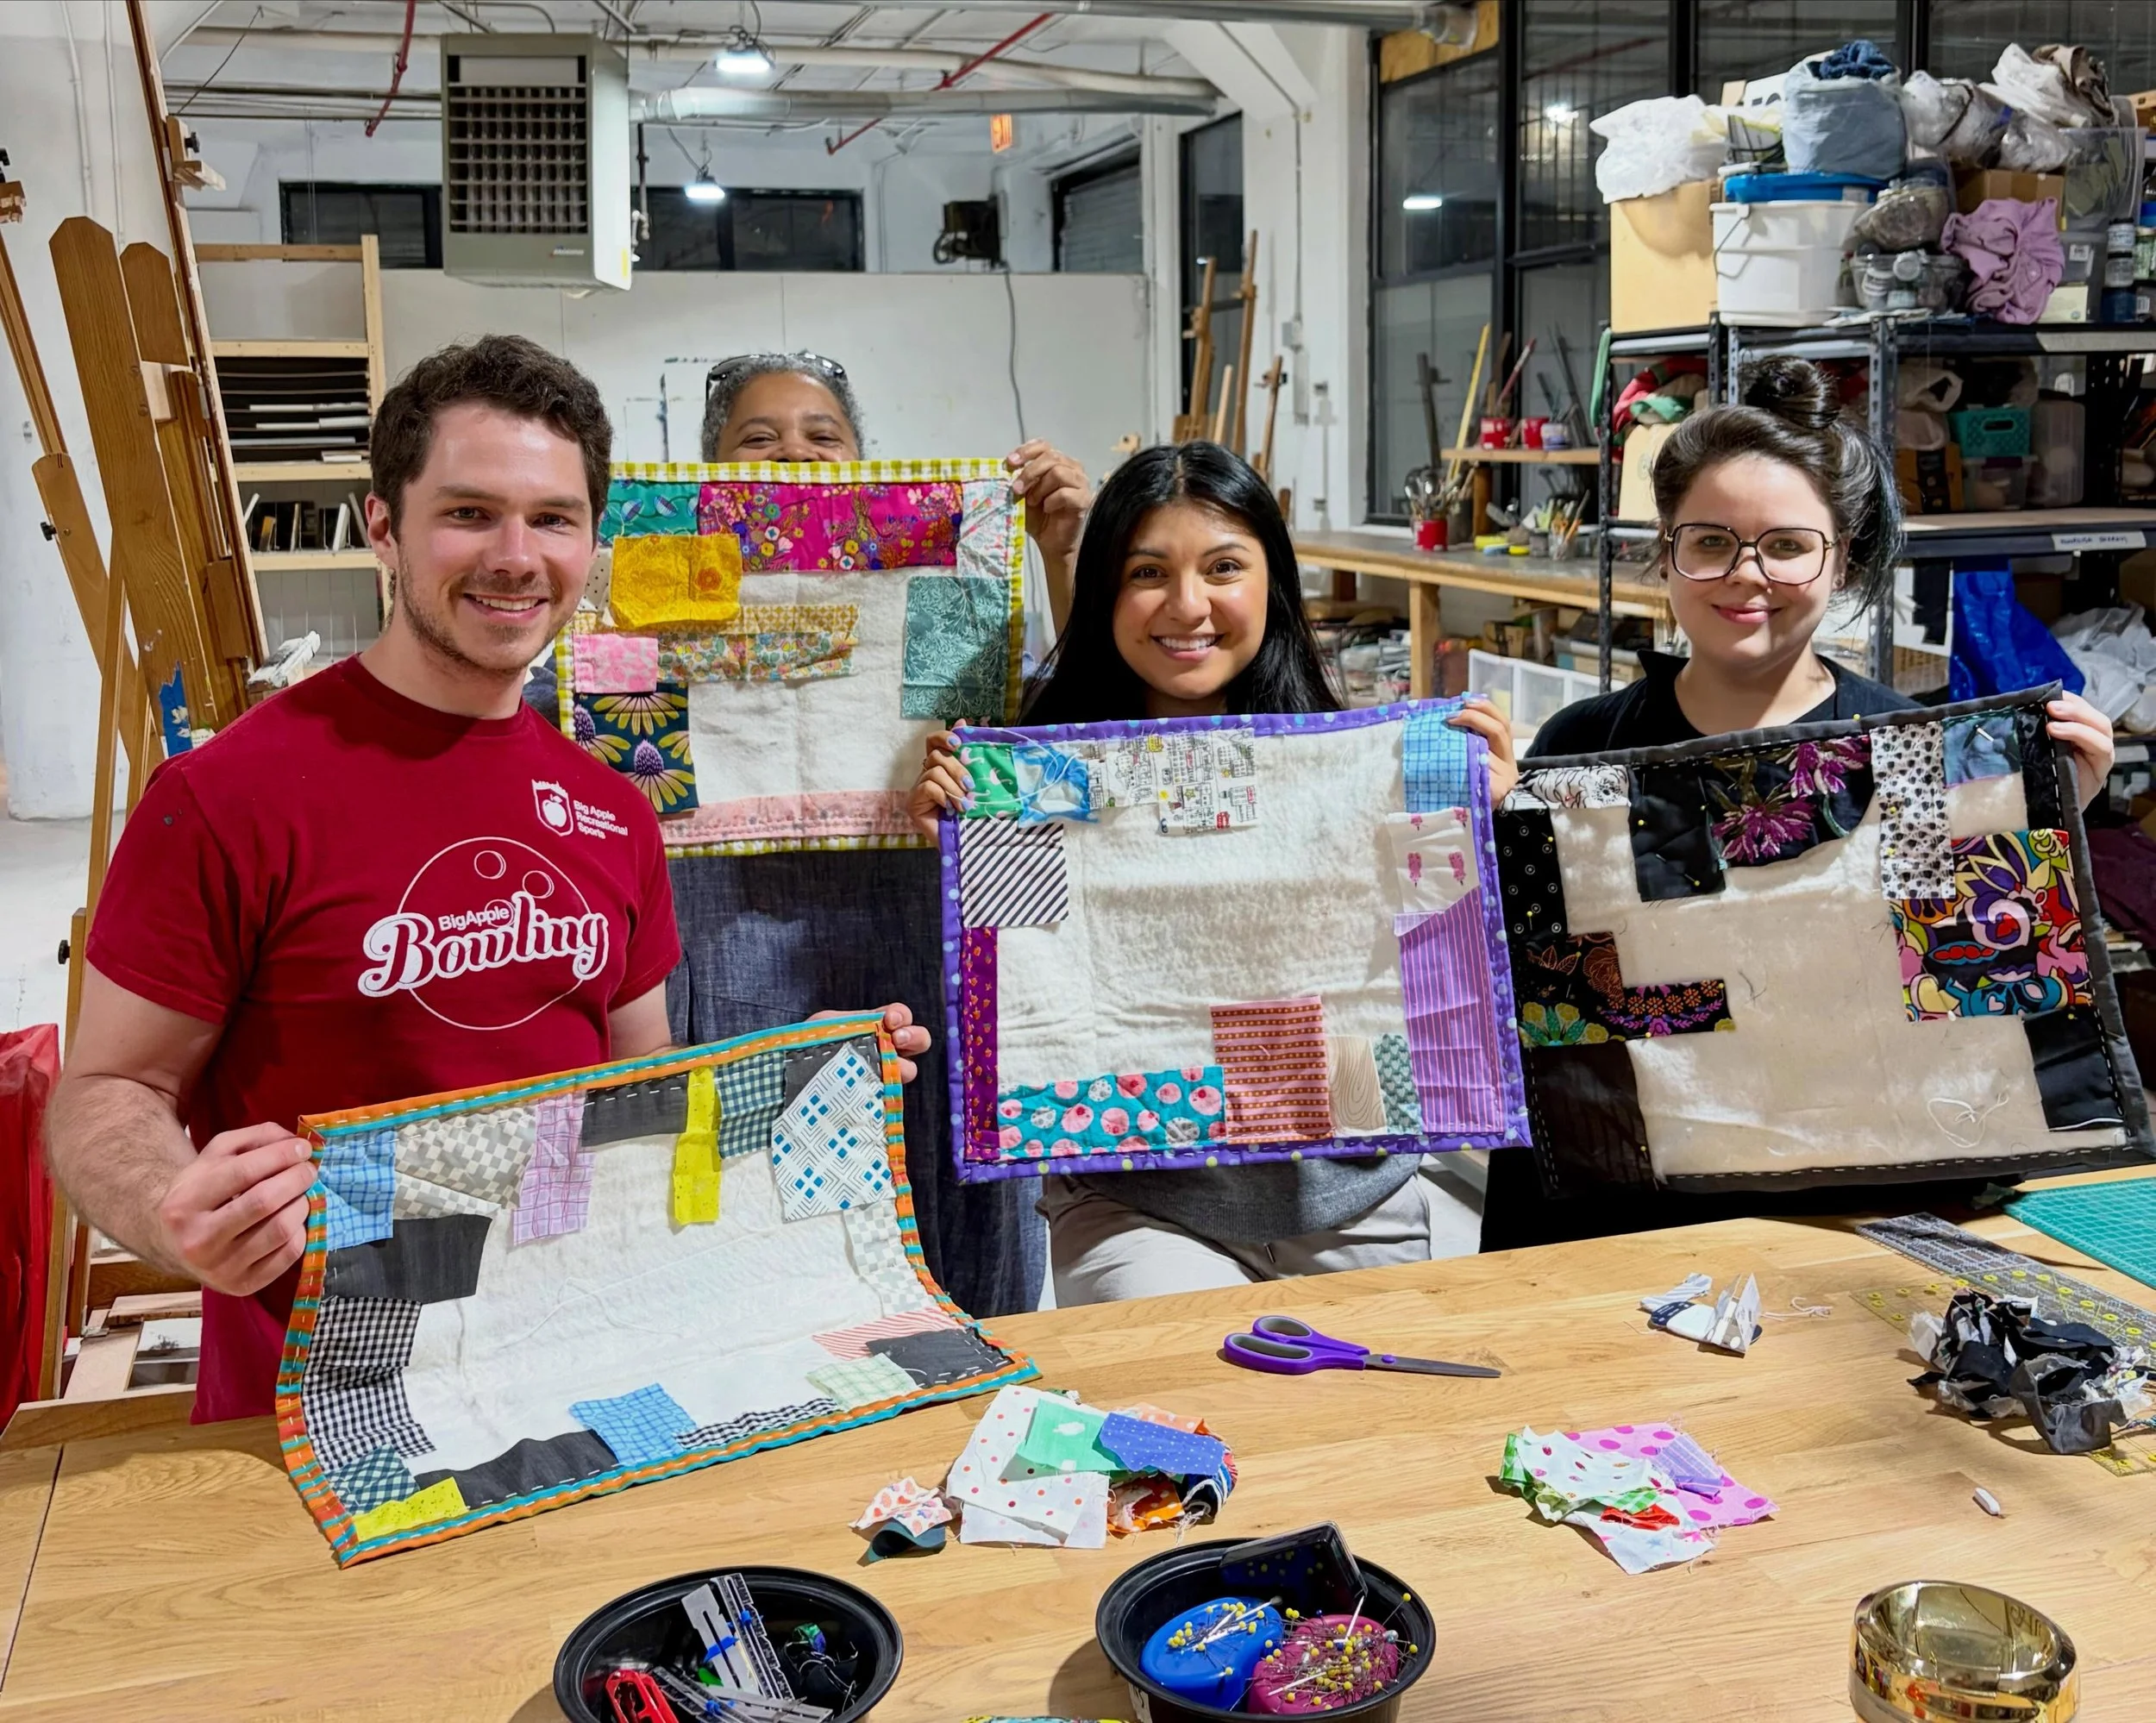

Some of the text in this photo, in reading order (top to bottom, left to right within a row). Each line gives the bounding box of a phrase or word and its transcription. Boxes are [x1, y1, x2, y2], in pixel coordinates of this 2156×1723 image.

[573, 799, 617, 822] Big Apple
[575, 811, 629, 836] Recreational
[577, 821, 606, 840] Sports
[357, 891, 609, 998] Bowling
